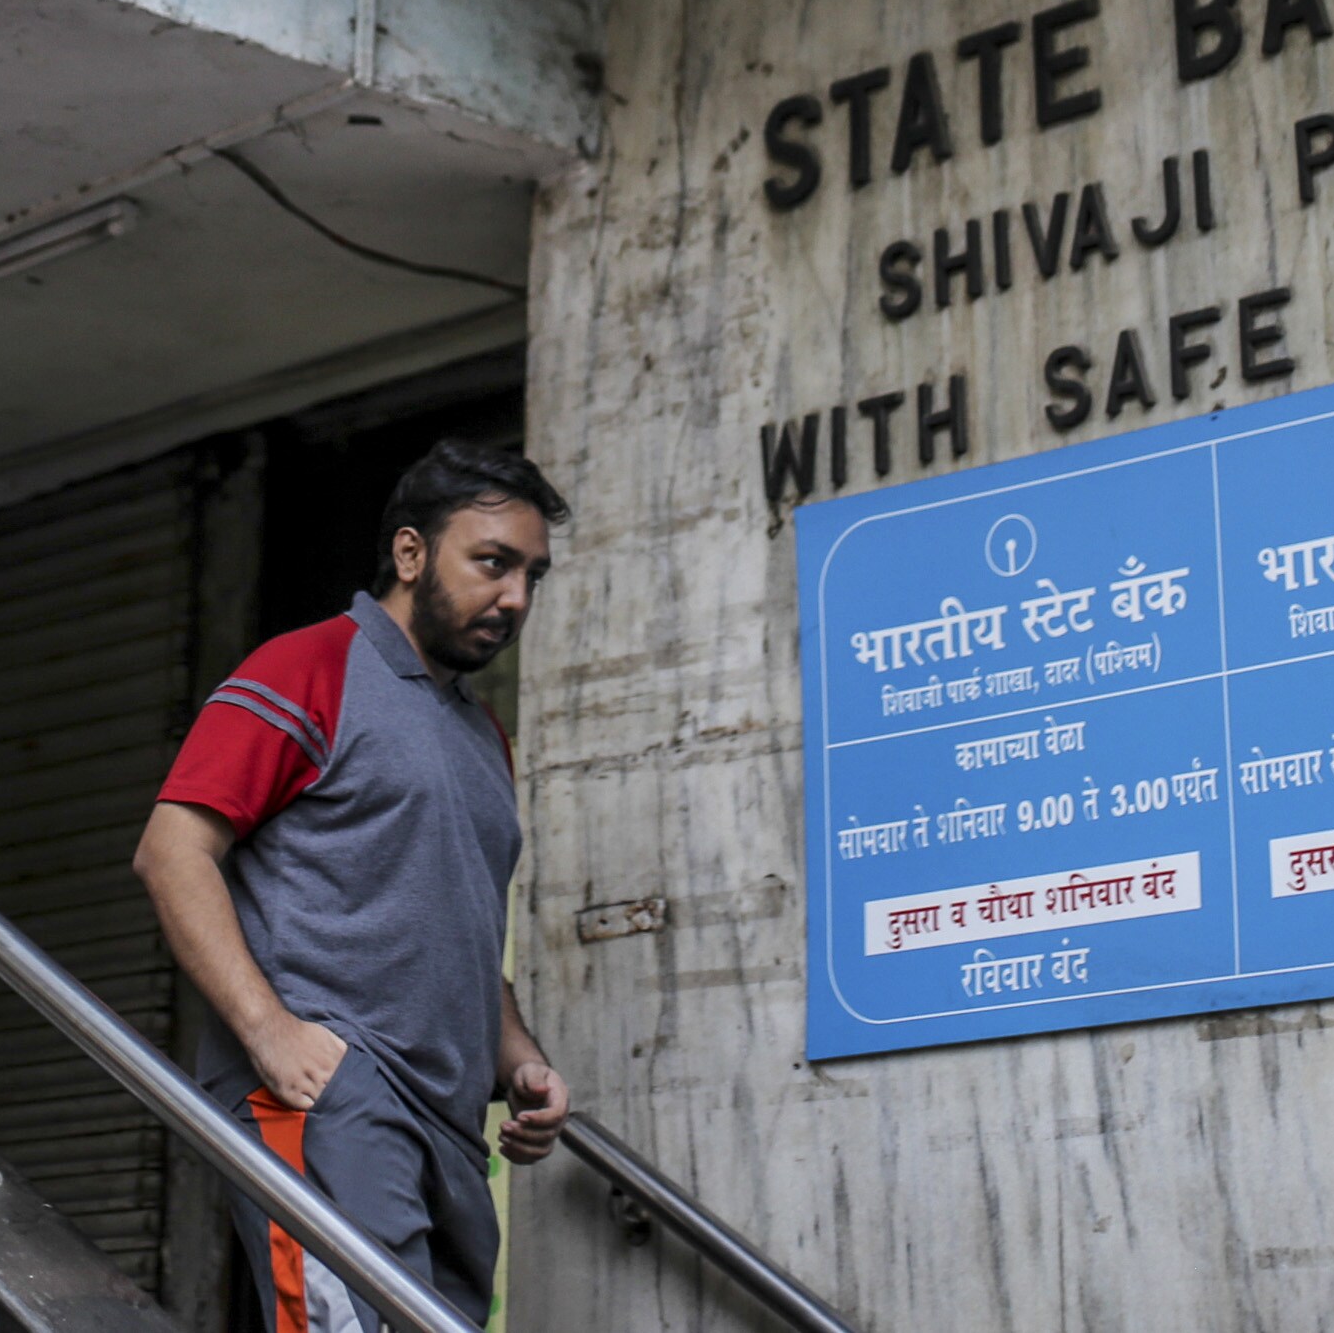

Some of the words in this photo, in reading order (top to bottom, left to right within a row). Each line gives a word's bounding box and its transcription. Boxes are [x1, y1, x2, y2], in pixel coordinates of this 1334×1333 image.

[879, 149, 1215, 323] SHIVAJI
[760, 375, 968, 504] WITH
[1044, 288, 1296, 433] SAFE
[850, 597, 1008, 673] भारतीय
[1020, 578, 1096, 643] स्टेट
[1109, 555, 1190, 623] बँक
[881, 675, 943, 716] शिवाजी
[947, 668, 981, 702] पार्क
[1045, 657, 1081, 684] दादर
[955, 729, 1040, 771] कामाच्या
[1045, 716, 1085, 752] वेळा
[1240, 747, 1323, 795] सोमवार
[838, 816, 908, 860] सोमवार
[913, 805, 928, 848] ते
[937, 799, 1006, 845] शनिवार
[1017, 794, 1074, 832] 9.00
[1083, 777, 1099, 821] ते
[1110, 777, 1168, 817] 3.00
[887, 905, 939, 950] दुसरा
[951, 901, 967, 927] व
[978, 884, 1034, 923] चौथा
[1046, 874, 1133, 913] शनिवार
[1143, 864, 1176, 900] बंद
[960, 948, 1044, 998] रविवार
[1051, 938, 1090, 983] बंद
